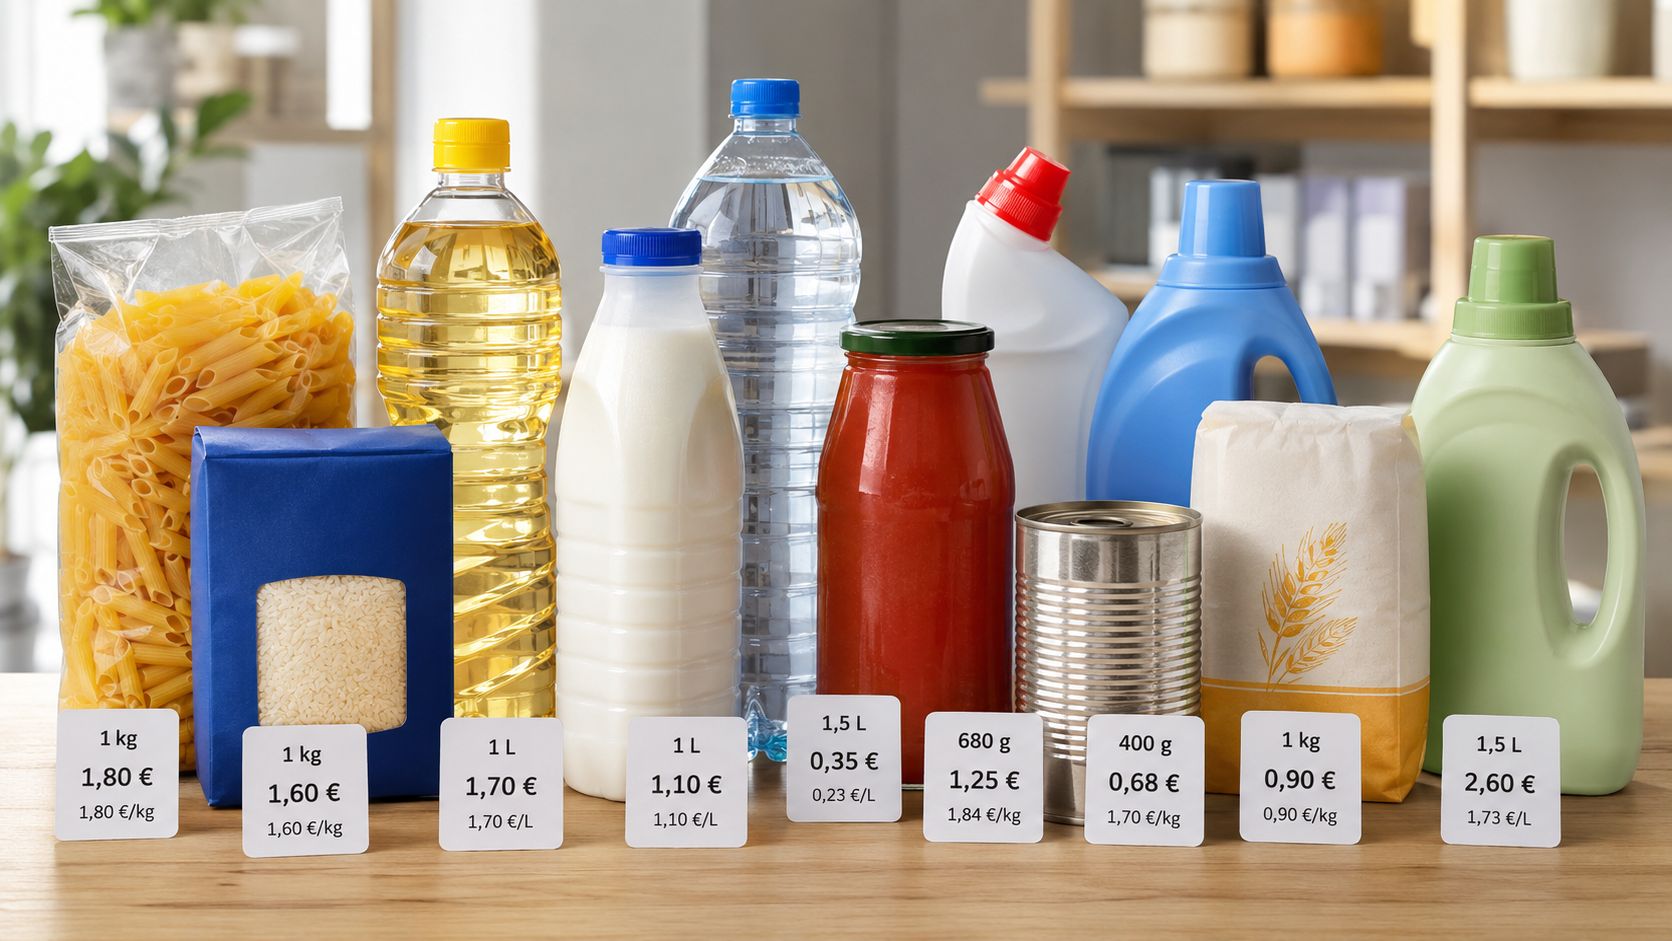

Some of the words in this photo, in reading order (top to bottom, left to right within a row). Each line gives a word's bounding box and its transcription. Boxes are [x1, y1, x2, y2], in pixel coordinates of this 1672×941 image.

[822, 714, 850, 735] 1,5
[856, 715, 867, 732] L
[100, 730, 111, 747] 1
[115, 729, 138, 751] kg
[488, 738, 500, 756] 1
[505, 738, 516, 756] L
[673, 737, 684, 754] 1
[690, 737, 701, 754] L
[958, 732, 994, 750] 680
[999, 736, 1011, 754] g
[1118, 734, 1155, 752] 400
[1160, 739, 1173, 757] g
[1282, 731, 1293, 748] 1
[1299, 731, 1321, 754] kg
[1477, 735, 1506, 755] 1,5
[1511, 736, 1523, 753] L
[282, 746, 294, 763] 1
[299, 745, 322, 767] kg
[810, 751, 859, 774] 0,35
[864, 751, 879, 771] €
[81, 766, 132, 791] 1,80
[138, 766, 154, 787] €
[465, 776, 516, 800] 1,70
[522, 776, 538, 796] €
[651, 774, 701, 798] 1,10
[707, 774, 722, 795] €
[949, 769, 999, 793] 1,25
[1005, 770, 1020, 791] €
[1108, 771, 1159, 796] 0,68
[1165, 773, 1180, 793] €
[1264, 768, 1315, 793] 0,90
[1321, 770, 1336, 791] €
[1464, 771, 1515, 796] 2,60
[1520, 774, 1536, 794] €
[268, 782, 319, 807] 1,60
[325, 782, 341, 802] €
[812, 787, 846, 804] 0,23
[849, 787, 876, 804] €/L
[79, 804, 114, 822] 1,80
[118, 803, 155, 823] €/kg
[468, 814, 503, 832] 1,70
[507, 813, 534, 831] €/L
[653, 811, 688, 829] 1,10
[691, 811, 718, 829] €/L
[948, 807, 982, 824] 1,84
[985, 806, 1022, 826] €/kg
[1107, 809, 1141, 826] 1,70
[1145, 809, 1181, 830] €/kg
[1263, 806, 1298, 824] 0,90
[1301, 807, 1338, 827] €/kg
[1467, 809, 1501, 827] 1,73
[1505, 810, 1532, 828] €/L
[267, 820, 303, 839] 1,60
[306, 819, 343, 838] €/kg
